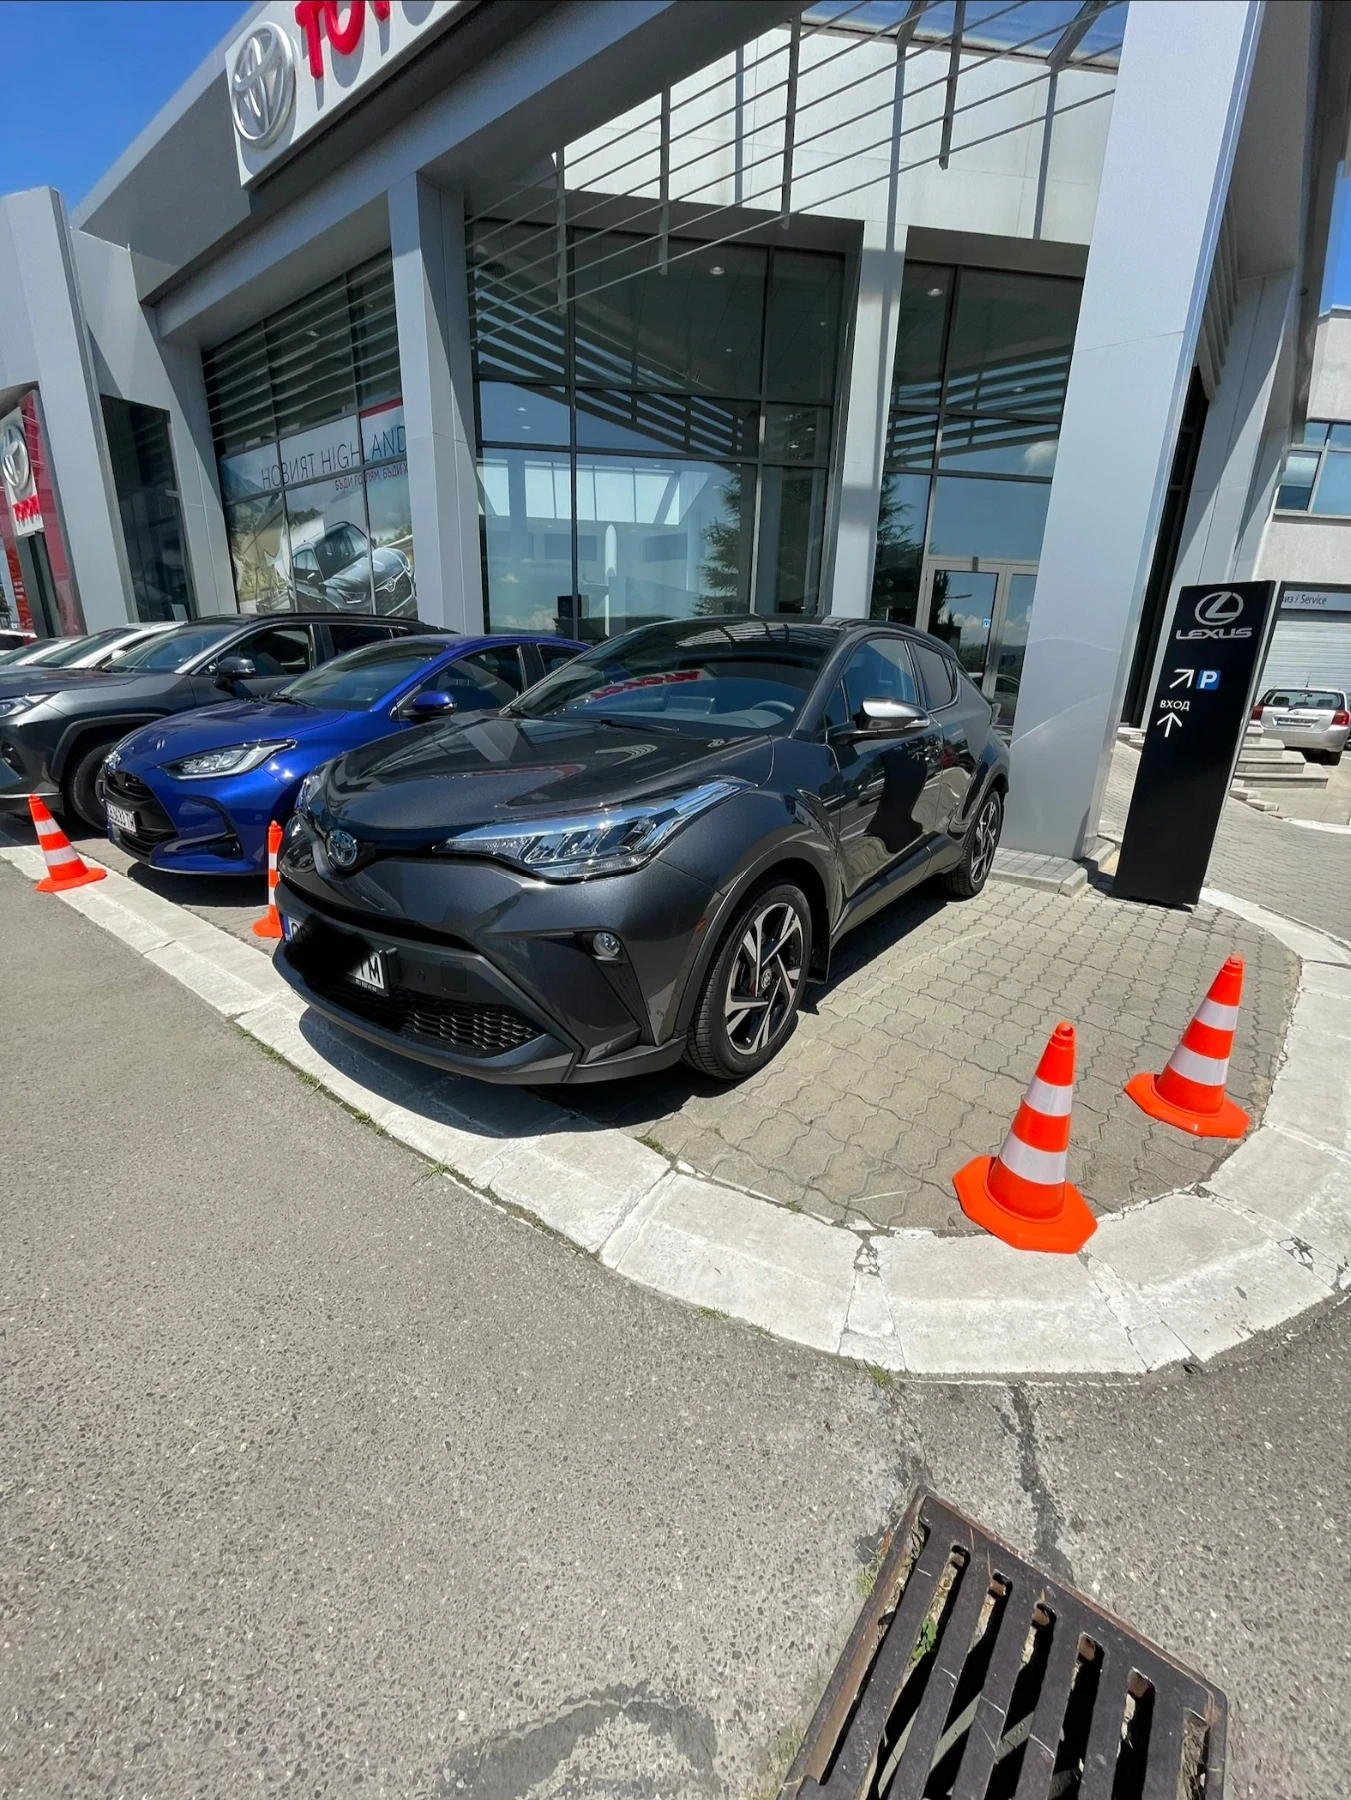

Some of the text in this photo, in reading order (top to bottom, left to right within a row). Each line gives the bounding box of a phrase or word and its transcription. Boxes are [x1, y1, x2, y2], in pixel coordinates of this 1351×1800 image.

[261, 452, 315, 490] НОВИЯТ
[1300, 594, 1327, 605] Service
[1175, 627, 1253, 640] LEXUS
[1201, 671, 1218, 689] P
[1159, 699, 1190, 711] ВХОД
